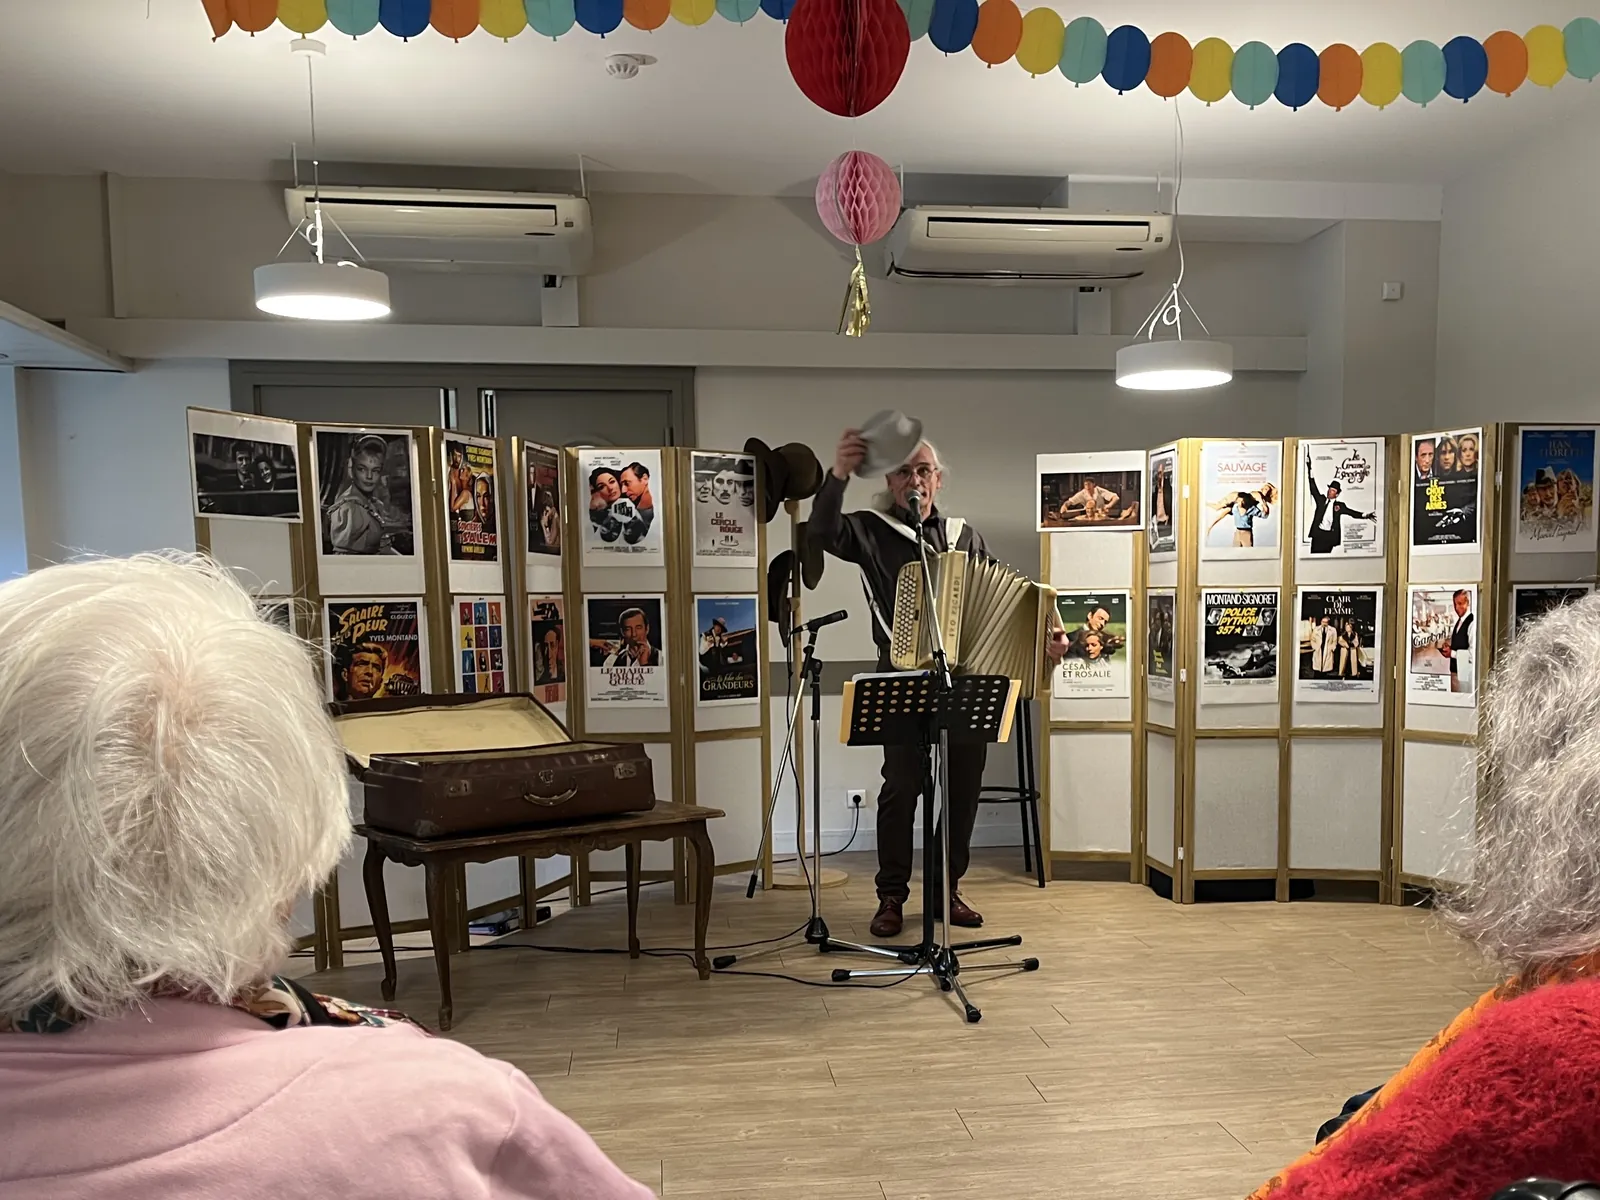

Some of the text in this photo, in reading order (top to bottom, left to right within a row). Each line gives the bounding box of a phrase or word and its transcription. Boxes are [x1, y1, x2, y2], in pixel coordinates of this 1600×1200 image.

[1217, 462, 1267, 472] SAUVAGE
[1430, 479, 1438, 487] LE
[711, 518, 737, 526] CERCLE
[462, 531, 497, 546] SALEM
[1325, 595, 1351, 603] CLAIR
[1333, 601, 1344, 609] DE
[1224, 607, 1258, 617] POLICE
[1324, 607, 1354, 615] FEMME
[1220, 616, 1259, 626] PYTHON
[1216, 625, 1235, 635] 357
[1062, 661, 1091, 671] CÉSAR
[609, 679, 645, 687] QUEUE
[702, 680, 754, 691] GRANDEURS
